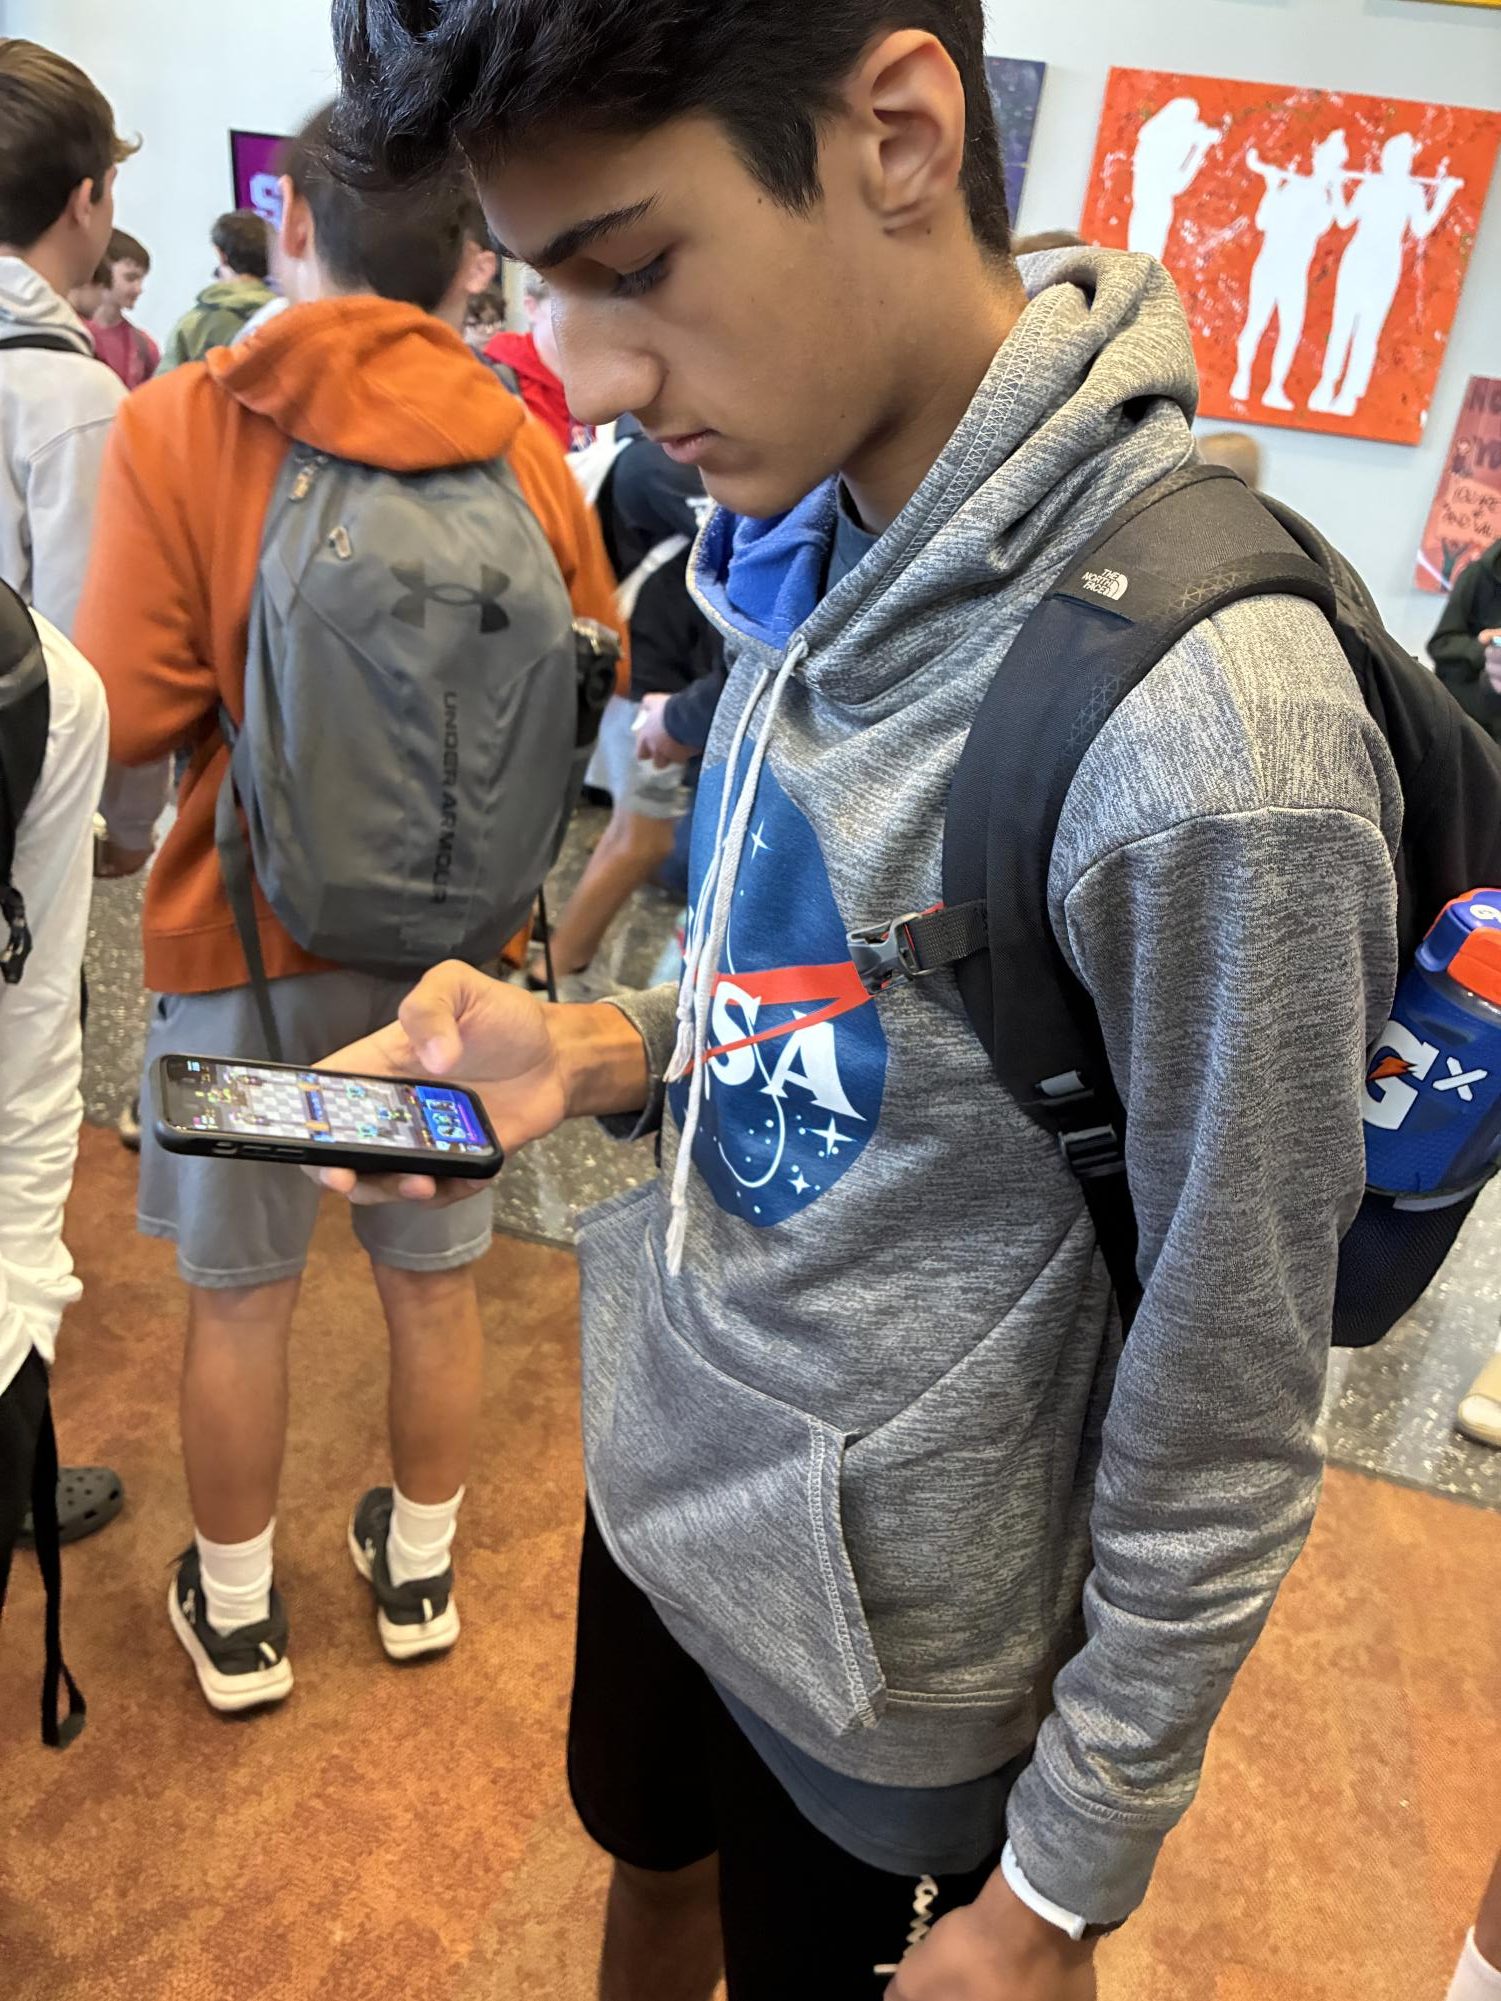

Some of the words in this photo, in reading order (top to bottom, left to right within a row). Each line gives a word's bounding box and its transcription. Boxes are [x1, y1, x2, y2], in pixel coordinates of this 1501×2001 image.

[1081, 571, 1113, 587] NORTH
[1101, 568, 1120, 580] THE
[1083, 581, 1106, 594] FACE
[443, 691, 458, 786] UNDER
[432, 791, 457, 904] ARMOUR
